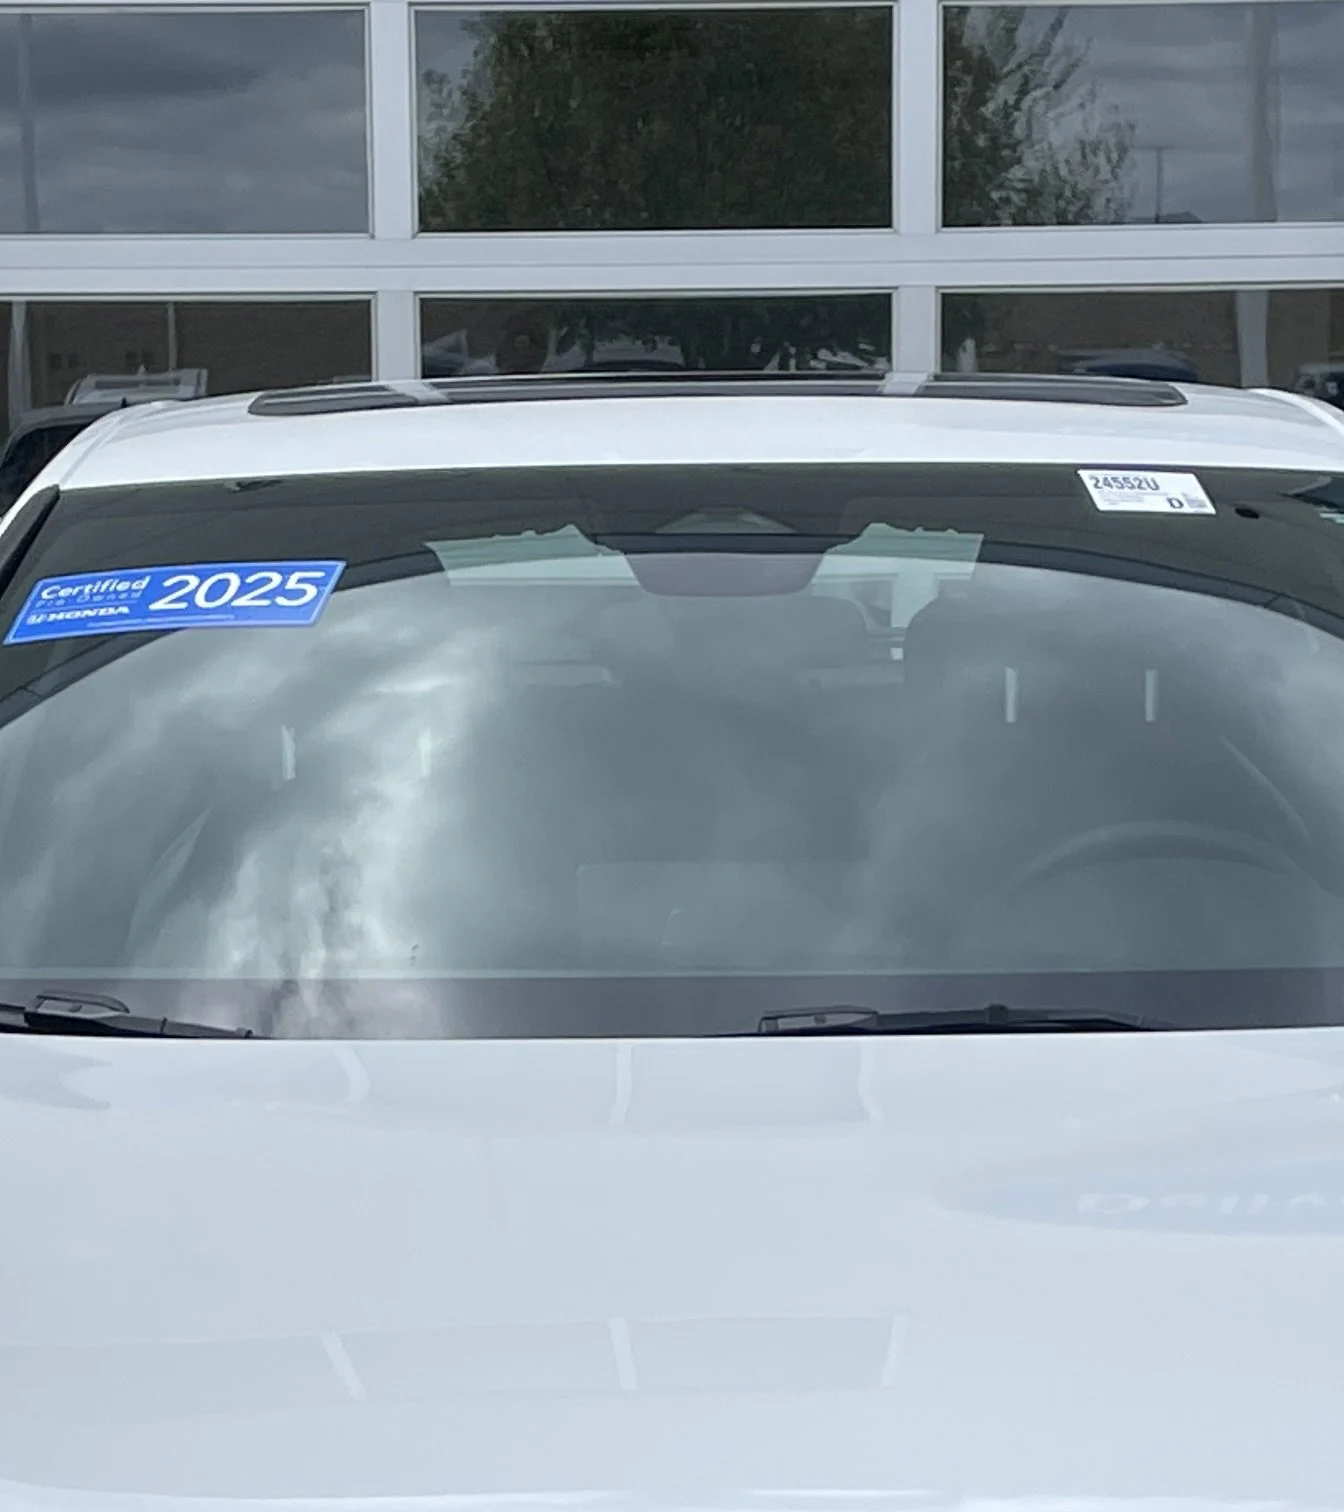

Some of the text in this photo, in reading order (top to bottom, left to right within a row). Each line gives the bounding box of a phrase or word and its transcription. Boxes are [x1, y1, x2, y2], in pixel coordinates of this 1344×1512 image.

[41, 576, 151, 600] Certified
[149, 572, 325, 611] 2025
[47, 606, 130, 622] HONDA
